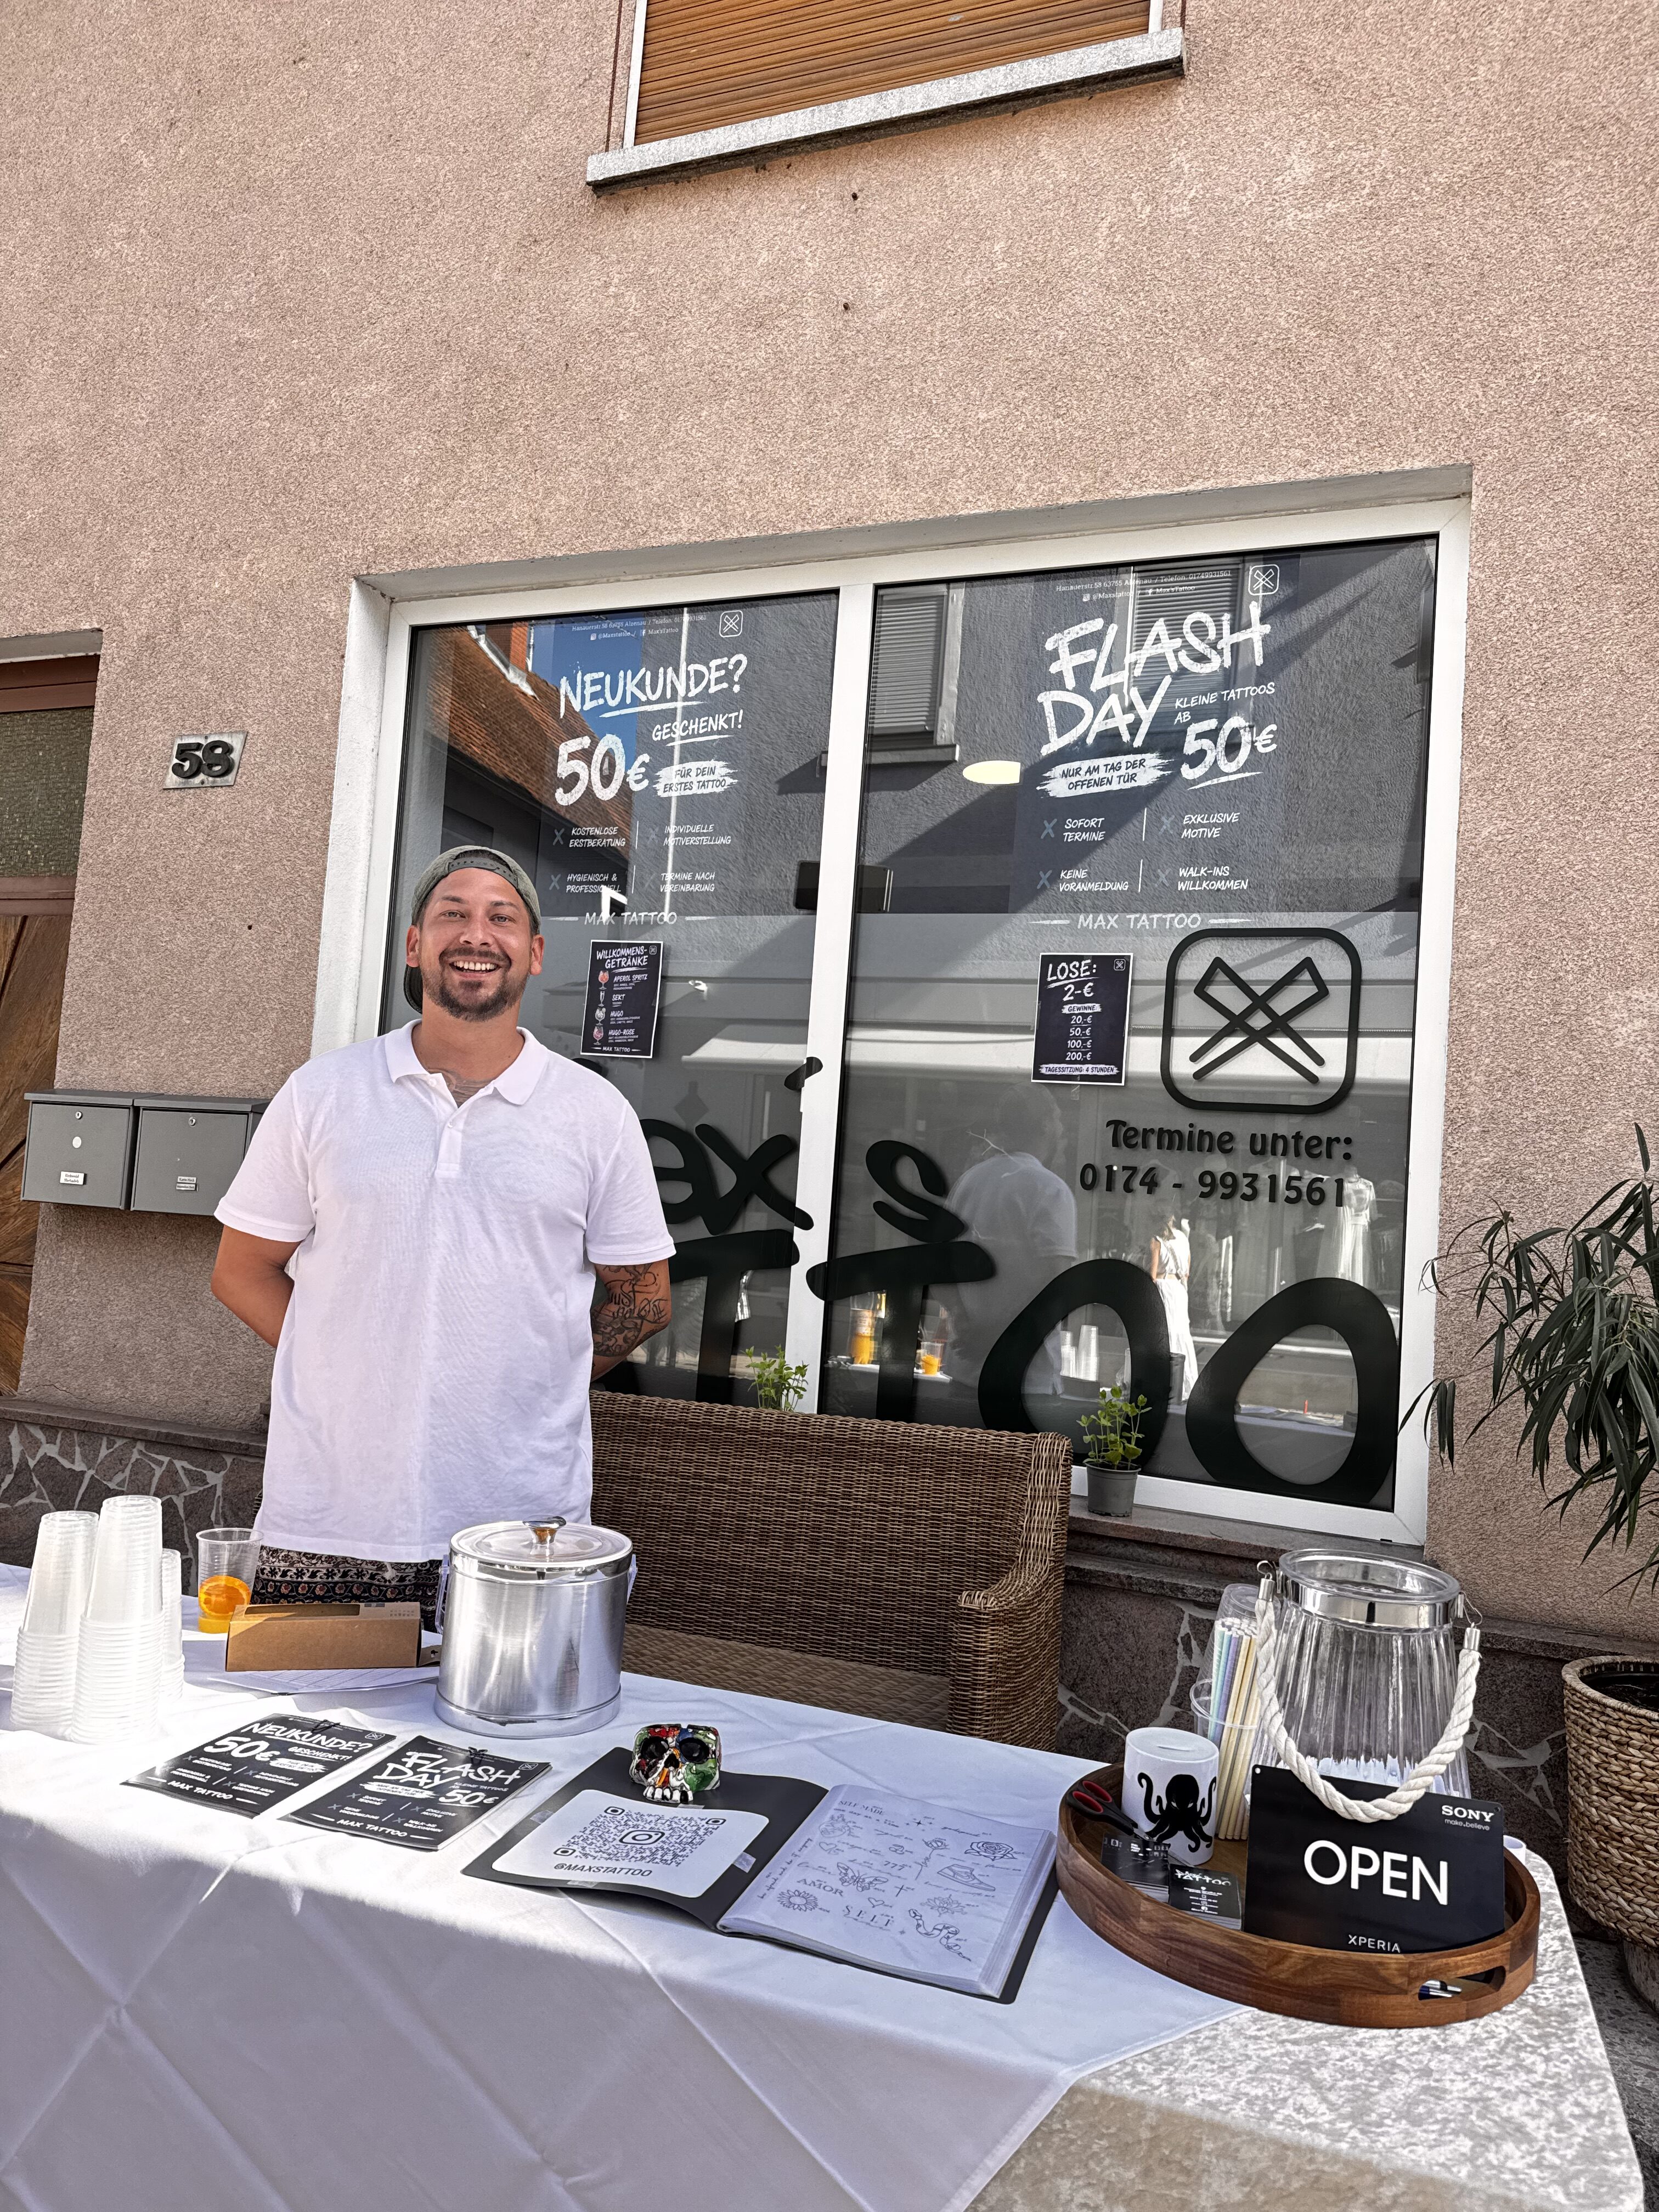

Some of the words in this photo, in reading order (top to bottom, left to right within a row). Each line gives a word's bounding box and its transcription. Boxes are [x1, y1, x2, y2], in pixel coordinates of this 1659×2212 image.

[1103, 580, 1122, 588] 63755
[1045, 601, 1271, 692] FLASH
[560, 653, 748, 719] NEUKUNDE?
[1175, 693, 1217, 710] KLEINE
[1221, 682, 1276, 703] TATTOOS
[1037, 675, 1172, 756] DAY
[1173, 711, 1192, 725] AB
[652, 709, 743, 741] GESCHENKT!
[1180, 715, 1278, 781] 50€
[172, 740, 235, 780] 58
[555, 733, 650, 806] 50€
[675, 768, 692, 778] FÜR
[695, 766, 716, 777] DEIN
[1061, 766, 1081, 778] NUR
[1084, 764, 1100, 776] AM
[1103, 761, 1122, 774] TAG
[1125, 758, 1146, 771] DER
[663, 780, 693, 793] ERSTES
[697, 778, 726, 791] TATTOO
[1068, 775, 1111, 791] OFFENEN
[1116, 772, 1137, 785] TÜR
[1064, 817, 1105, 829] SOFORT
[1183, 812, 1240, 824] EXKLUSIVE
[571, 827, 618, 836] KOSTENLOSE
[664, 824, 714, 834] INDIVIDUELLE
[1063, 831, 1105, 842] TERMINE
[1181, 827, 1221, 839] MOTIVE
[569, 838, 626, 848] ERSTBERATUNG
[663, 836, 731, 847] MOTIVERSTELLUNG
[567, 873, 609, 882] HYGIENISCH
[611, 872, 617, 882] &
[661, 872, 692, 881] TERMINE
[695, 871, 715, 880] NACH
[1060, 869, 1088, 879] KEINE
[1179, 866, 1230, 877] WALK-INS
[566, 884, 622, 894] PROFESSIOELL
[660, 883, 715, 893] VEREINBARUNG
[1059, 881, 1128, 892] VORANMELDUNG
[1177, 879, 1248, 891] WILLKOMMEN
[584, 912, 616, 925] MAX
[622, 911, 678, 926] TATTOO
[1077, 913, 1119, 930] MAX
[1126, 913, 1201, 929] TATTOO
[596, 945, 647, 960] WILLKOMMENS-
[605, 955, 648, 969] GETRÄNKE
[1047, 960, 1097, 981] LOSE:
[613, 974, 631, 983] APEROL
[1063, 982, 1094, 1002] 2-€
[1071, 1015, 1092, 1024] 20,-€
[1069, 1027, 1092, 1036] 50,-€
[1067, 1040, 1092, 1049] 100,-€
[1065, 1052, 1092, 1061] 200,-€
[1105, 1119, 1234, 1153] Termine
[1249, 1131, 1352, 1160] unter:
[1080, 1163, 1158, 1195] 0174
[1198, 1170, 1345, 1207] 9931561
[240, 1722, 374, 1753] NEUKUNDE?
[204, 1736, 281, 1761] 50€
[288, 1746, 352, 1761] GESCHENKT!
[373, 1762, 460, 1789] DAY
[402, 1751, 521, 1785] FLASH
[167, 1780, 194, 1791] MAX
[194, 1787, 233, 1799] TATTOO
[438, 1789, 499, 1805] 50€
[1442, 1805, 1495, 1822] SONY
[336, 1819, 364, 1827] MAX
[365, 1824, 408, 1837] TATTOO
[1444, 1819, 1490, 1831] make.believe
[554, 1863, 652, 1877] @MAXSTATTOO
[1304, 1839, 1448, 1906] OPEN
[797, 1878, 844, 1897] AMOR
[1348, 1934, 1401, 1954] XPERIA
